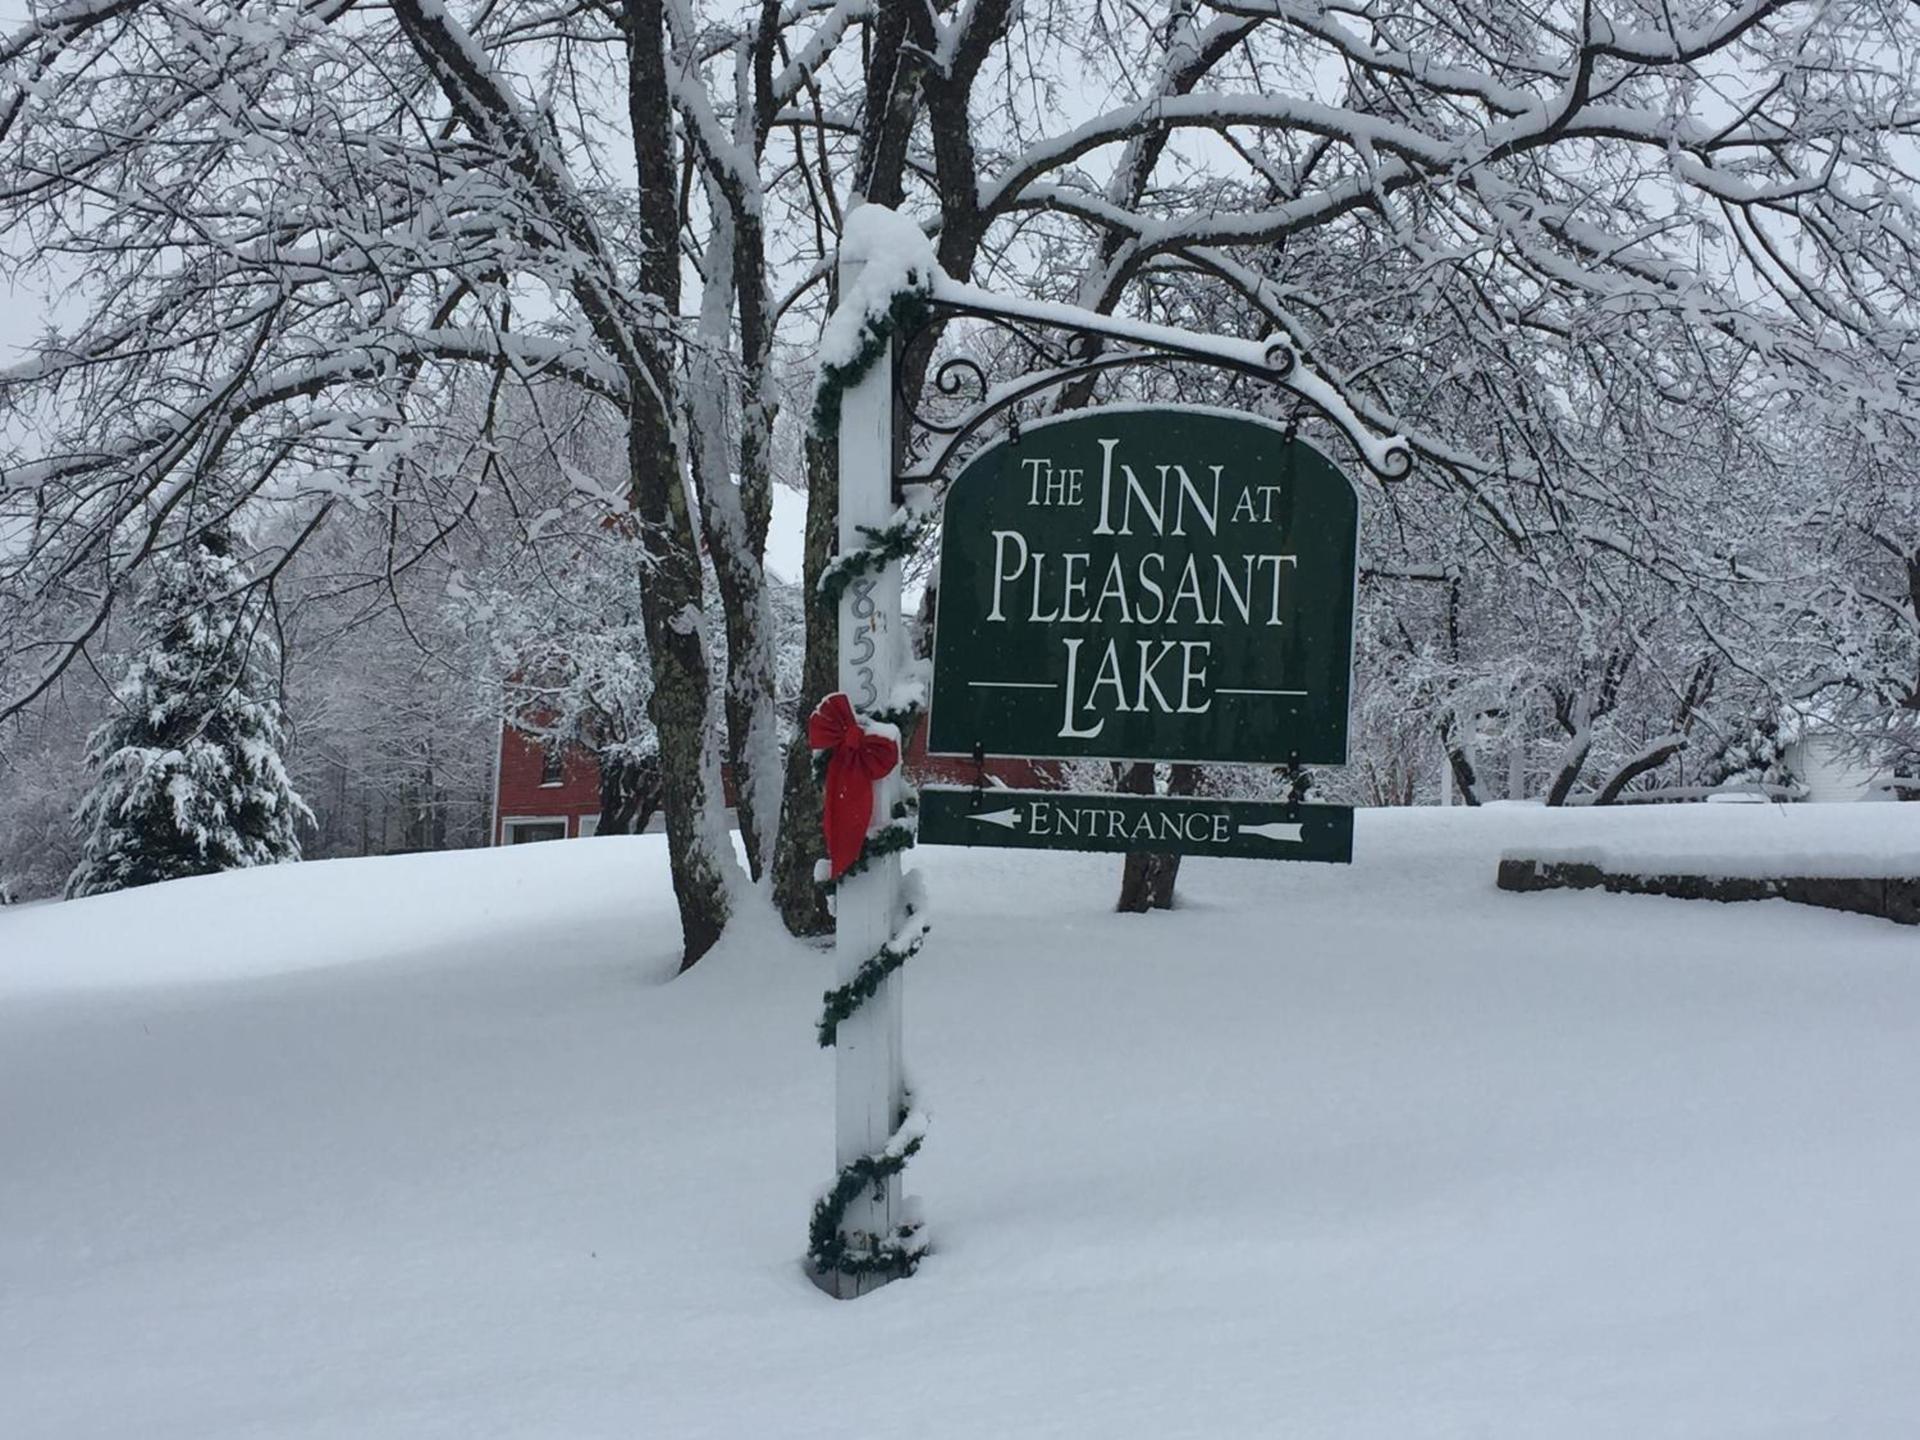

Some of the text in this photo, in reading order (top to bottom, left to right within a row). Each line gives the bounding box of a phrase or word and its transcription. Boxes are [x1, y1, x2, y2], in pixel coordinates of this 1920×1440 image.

[1021, 438, 1281, 536] THE INN AT
[986, 530, 1298, 626] PLEASANT
[850, 578, 878, 710] 853
[1057, 637, 1212, 738] LAKE
[1028, 802, 1232, 844] ENTRANCE
